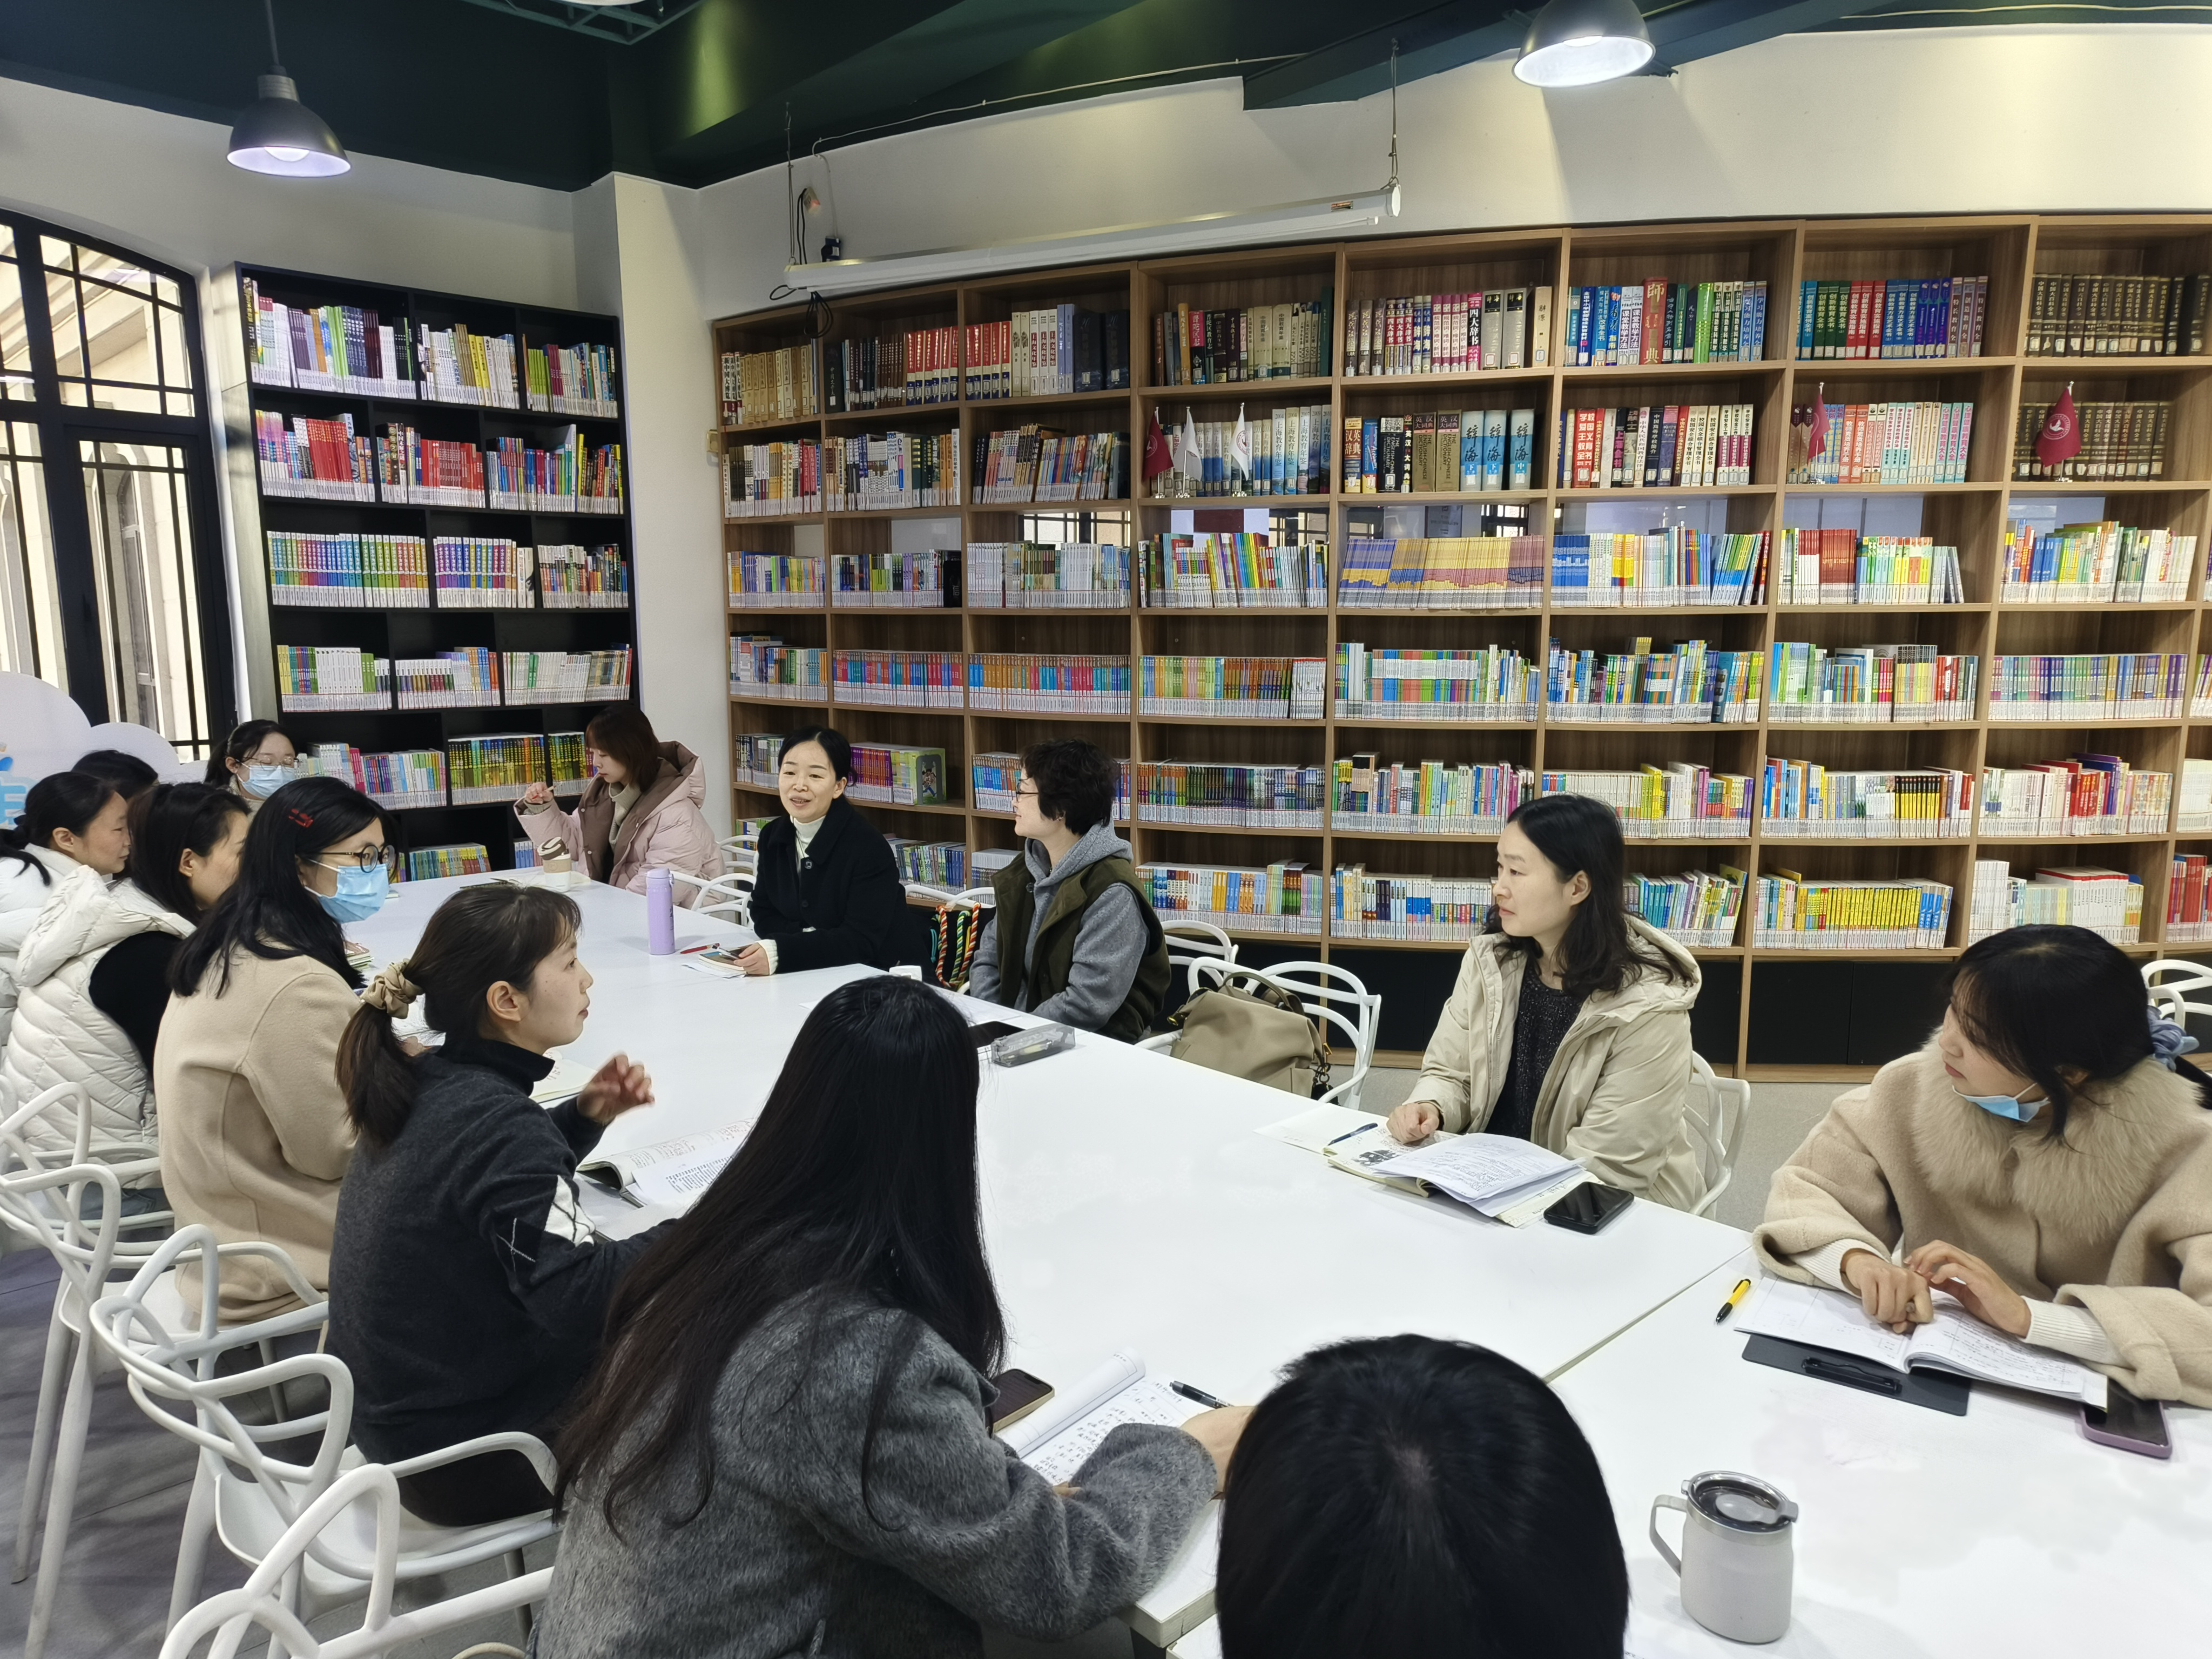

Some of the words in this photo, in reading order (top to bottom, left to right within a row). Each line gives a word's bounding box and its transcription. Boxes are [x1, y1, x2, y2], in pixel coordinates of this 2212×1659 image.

[1647, 283, 1664, 302] 師
[1816, 294, 1826, 329] 创新教育全书
[1827, 293, 1837, 328] 创新教育全书
[1838, 294, 1848, 329] 创新教育全书
[2035, 281, 2045, 316] 中国大百科全书
[2048, 281, 2056, 316] 中国大百科全书
[1469, 309, 1479, 346] 四大辞书
[1619, 310, 1630, 349] 课堂教学方法
[1630, 309, 1641, 348] 课堂教学方法
[1643, 348, 1659, 363] 典
[1345, 430, 1361, 442] 汉英
[1579, 413, 1595, 422] 学校
[1650, 414, 1660, 454] 中国高等学校简介
[1938, 407, 1950, 461] 心理健康教育大全
[1948, 406, 1960, 461] 心理健康教育大全
[1959, 406, 1972, 460] 心理健康教育大全
[1274, 421, 1283, 467] 上海教育年鉴
[1287, 420, 1296, 466] 上海教育年鉴
[1299, 419, 1309, 465] 上海教育年鉴
[1345, 443, 1361, 455] 辞典
[1405, 430, 1412, 447] 英汉
[1465, 424, 1478, 462] 辞海
[1487, 423, 1501, 462] 辞海
[1514, 423, 1529, 461] 辞海
[1577, 452, 1592, 460] 全书
[1578, 433, 1594, 441] 主义
[1685, 417, 1696, 466] 校园安全综合管理全书
[1695, 417, 1705, 465] 校园安全综合管理全书
[1707, 417, 1716, 466] 校园安全综合管理全书
